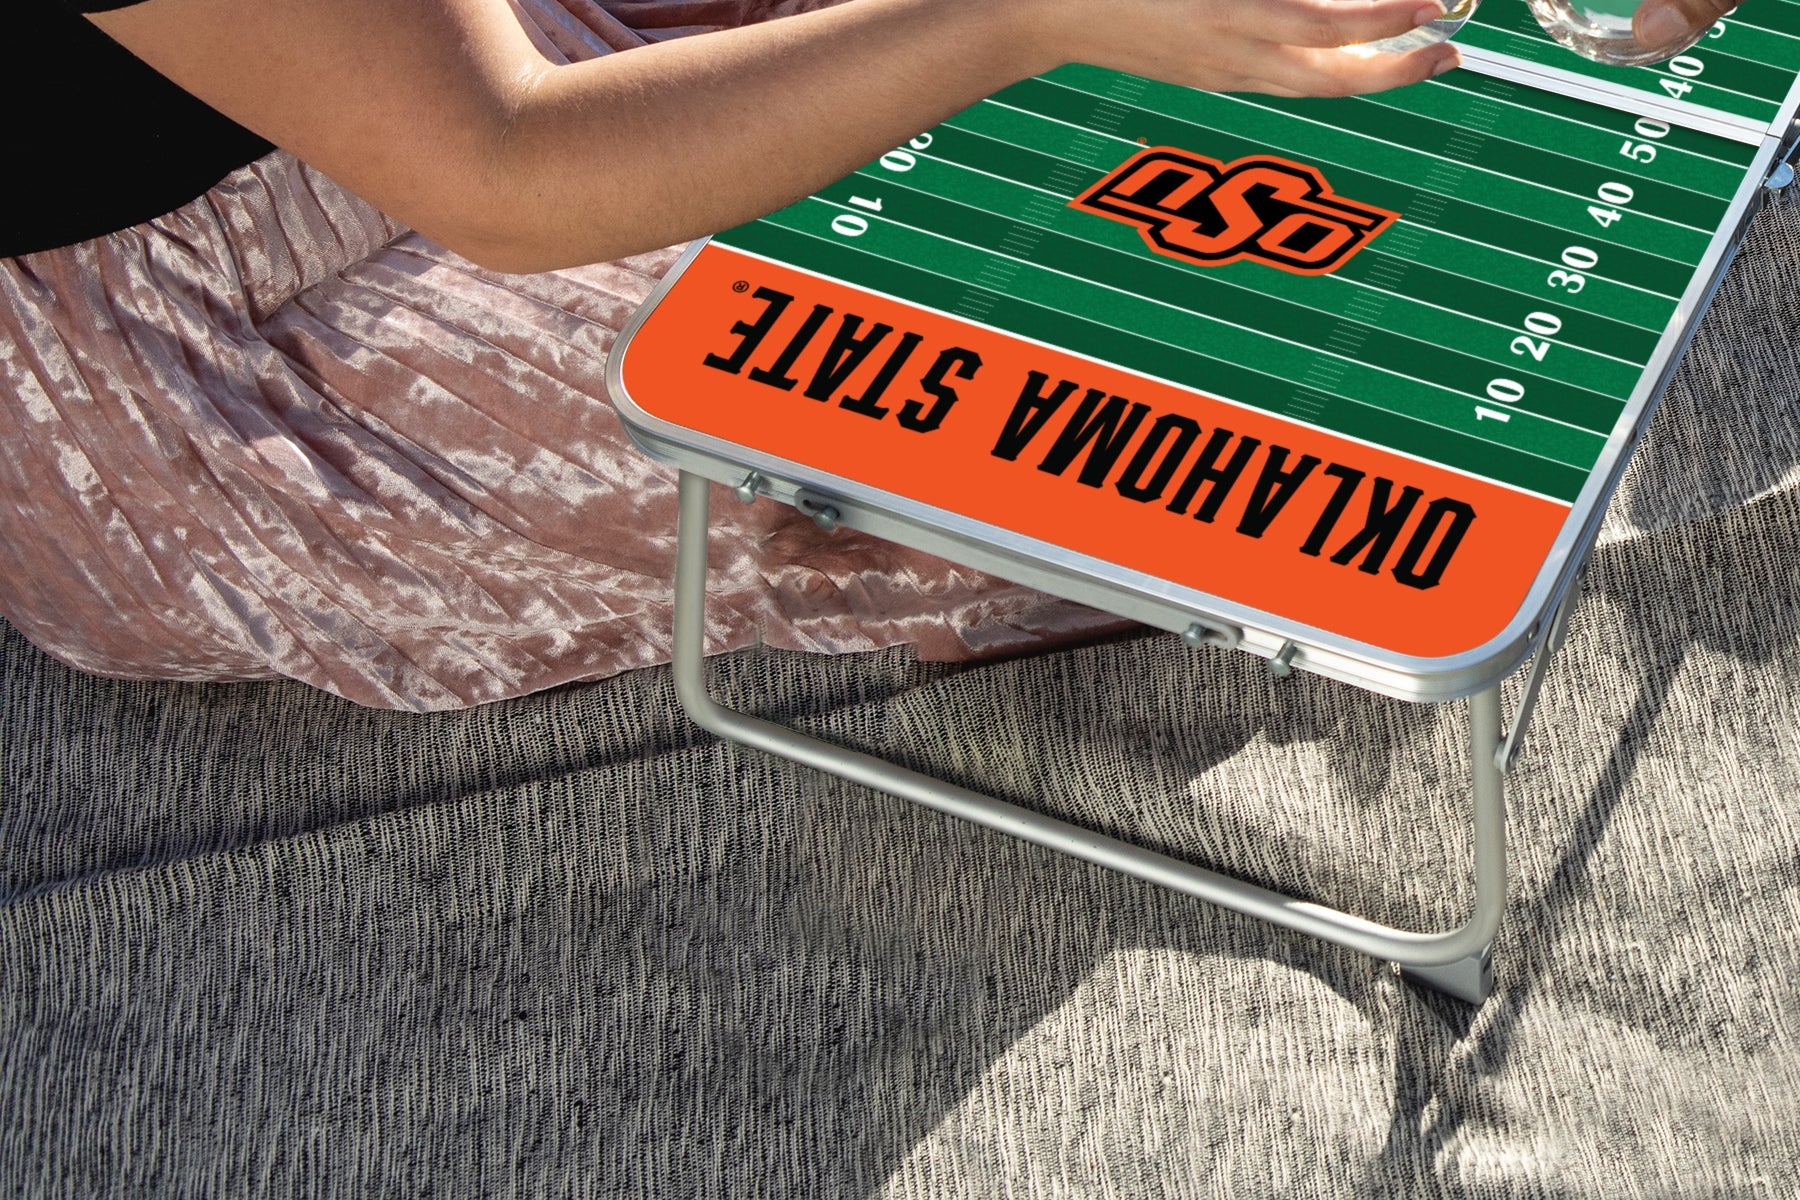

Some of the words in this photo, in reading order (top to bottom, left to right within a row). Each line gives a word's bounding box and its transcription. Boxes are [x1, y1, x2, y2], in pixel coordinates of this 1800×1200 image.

[1658, 55, 1705, 100] 40
[1618, 116, 1671, 164] 50
[831, 195, 883, 237] 10
[1066, 145, 1403, 277] OSU
[1586, 181, 1635, 229] 40
[1546, 246, 1600, 294] 30
[1509, 311, 1563, 362] 20
[1473, 378, 1526, 423] 10
[990, 370, 1478, 590] OKLAHOMA
